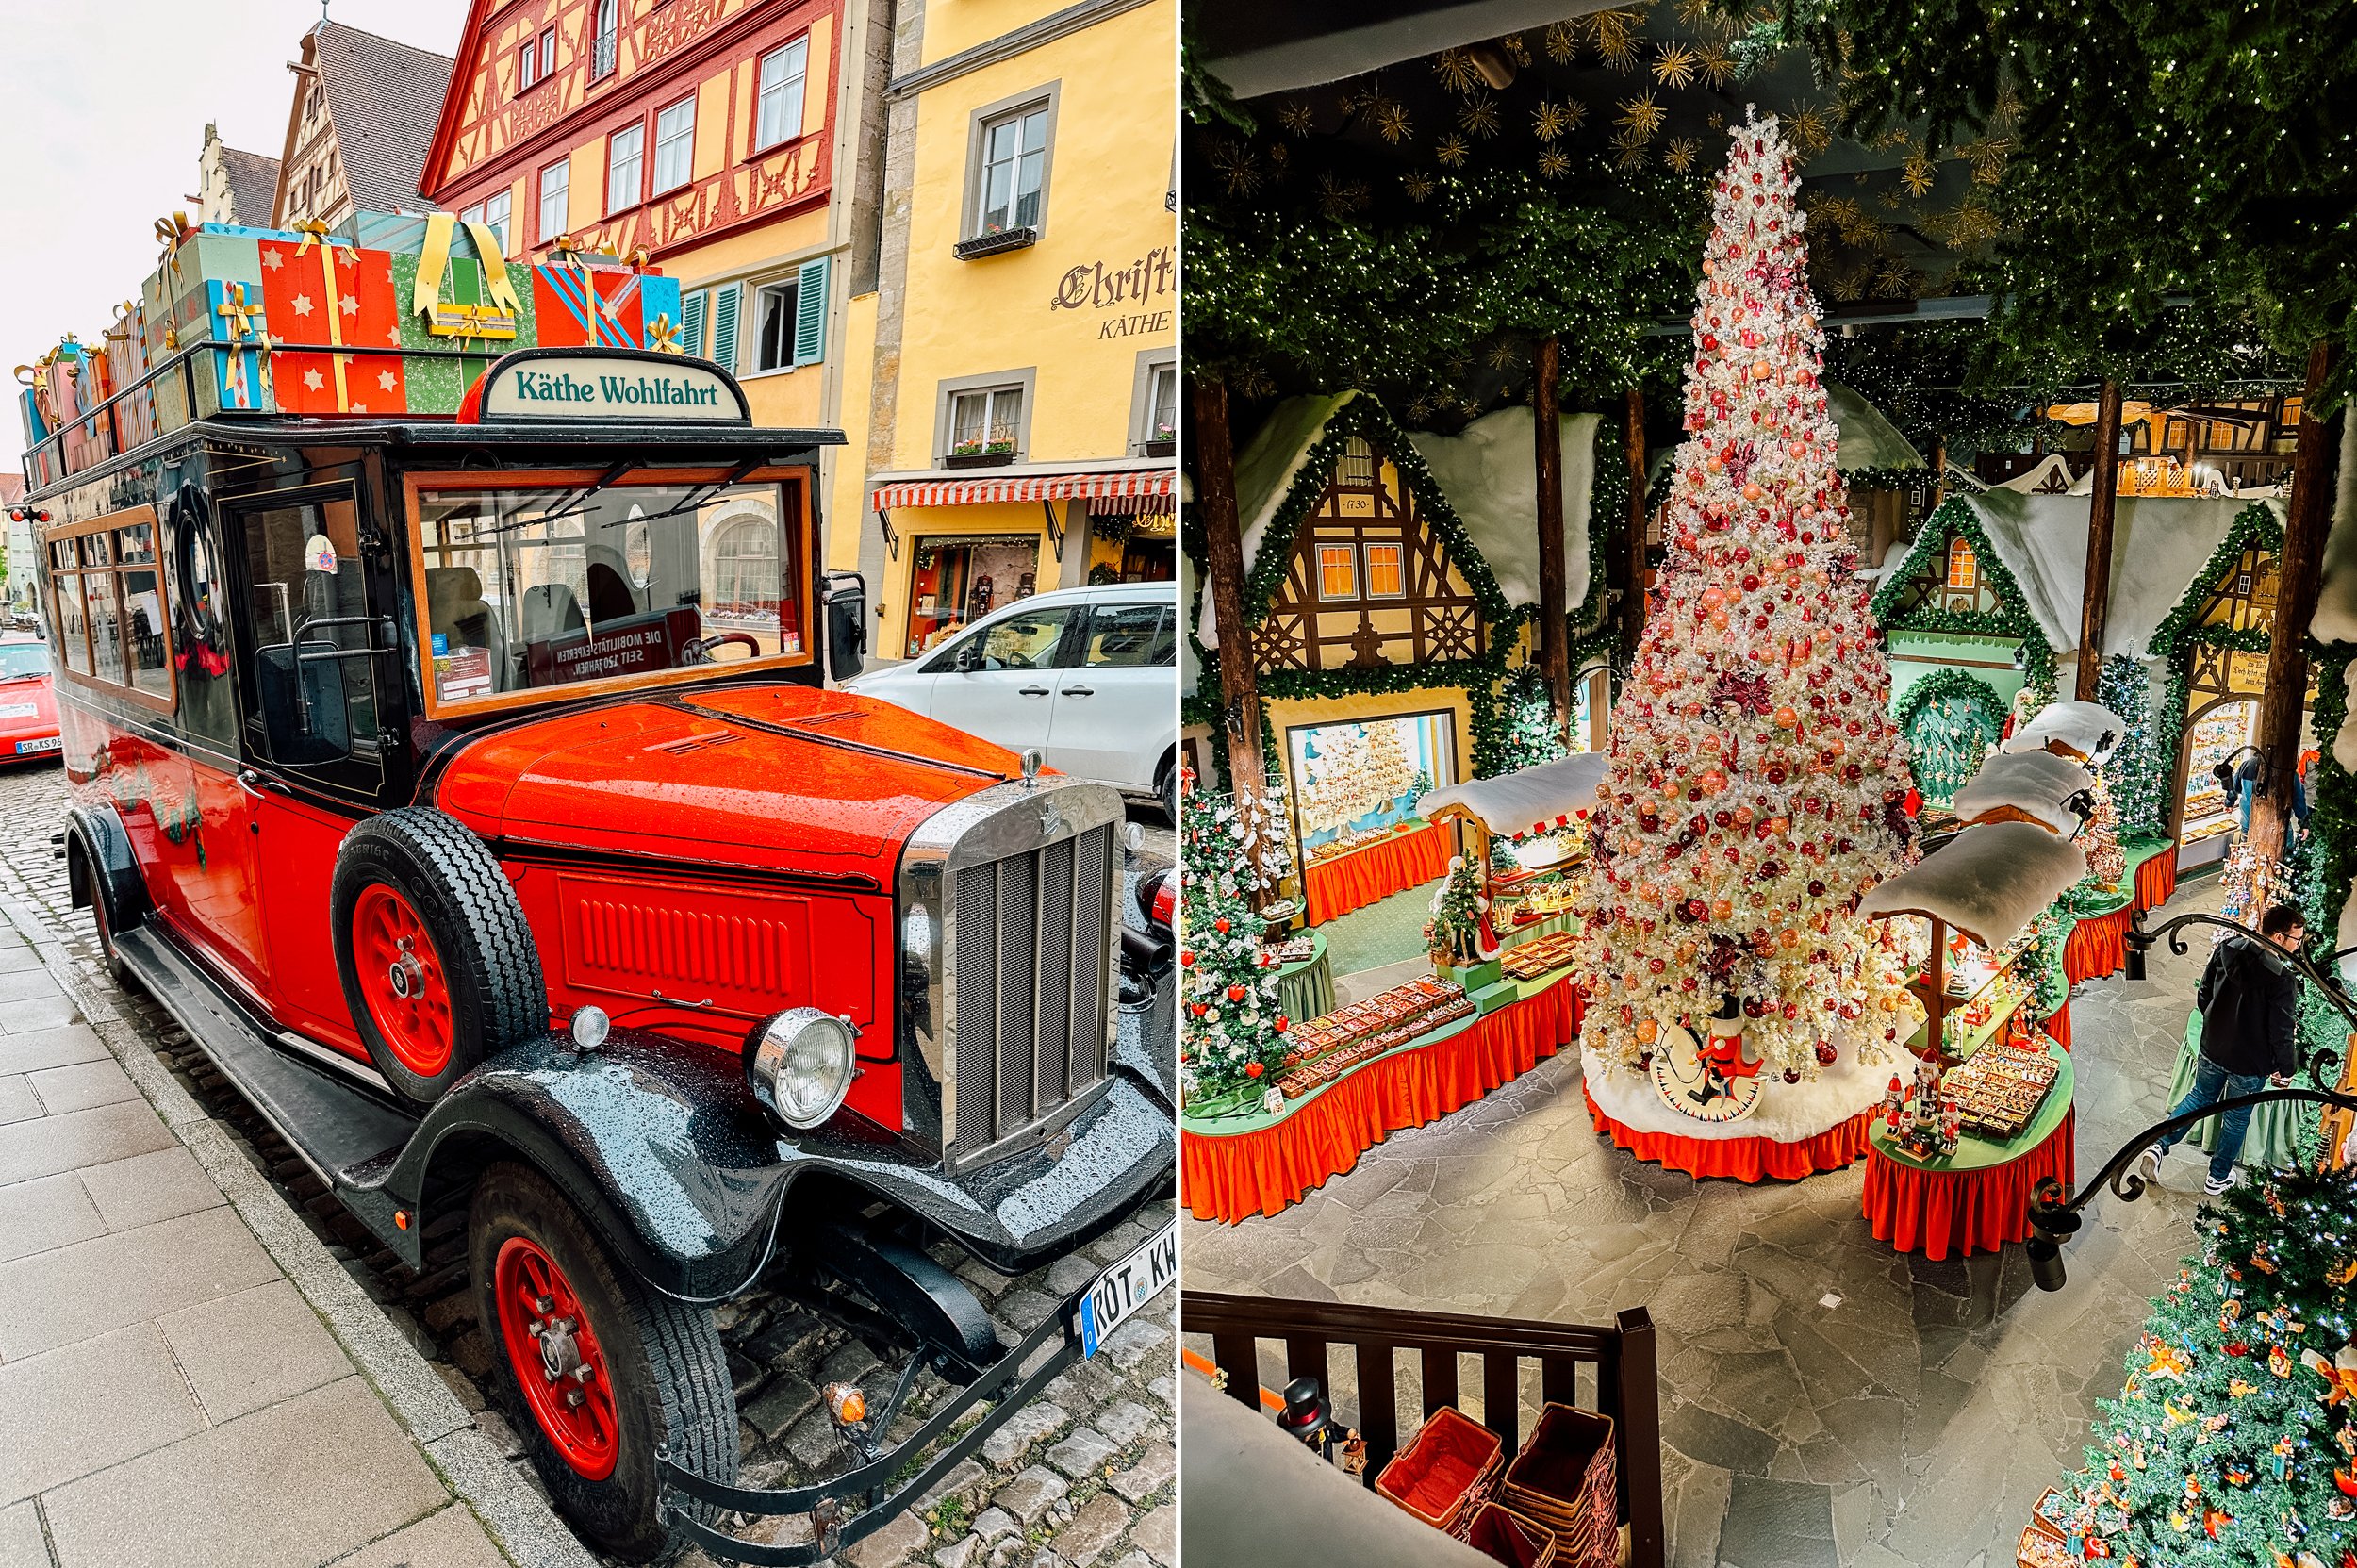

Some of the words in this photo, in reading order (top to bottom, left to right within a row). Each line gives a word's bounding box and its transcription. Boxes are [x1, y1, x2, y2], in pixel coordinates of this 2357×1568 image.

[515, 371, 596, 403] Käthe
[599, 375, 718, 405] Wohlfahrt
[23, 743, 33, 751] SR
[39, 739, 50, 749] KS
[1149, 1231, 1176, 1288] KW
